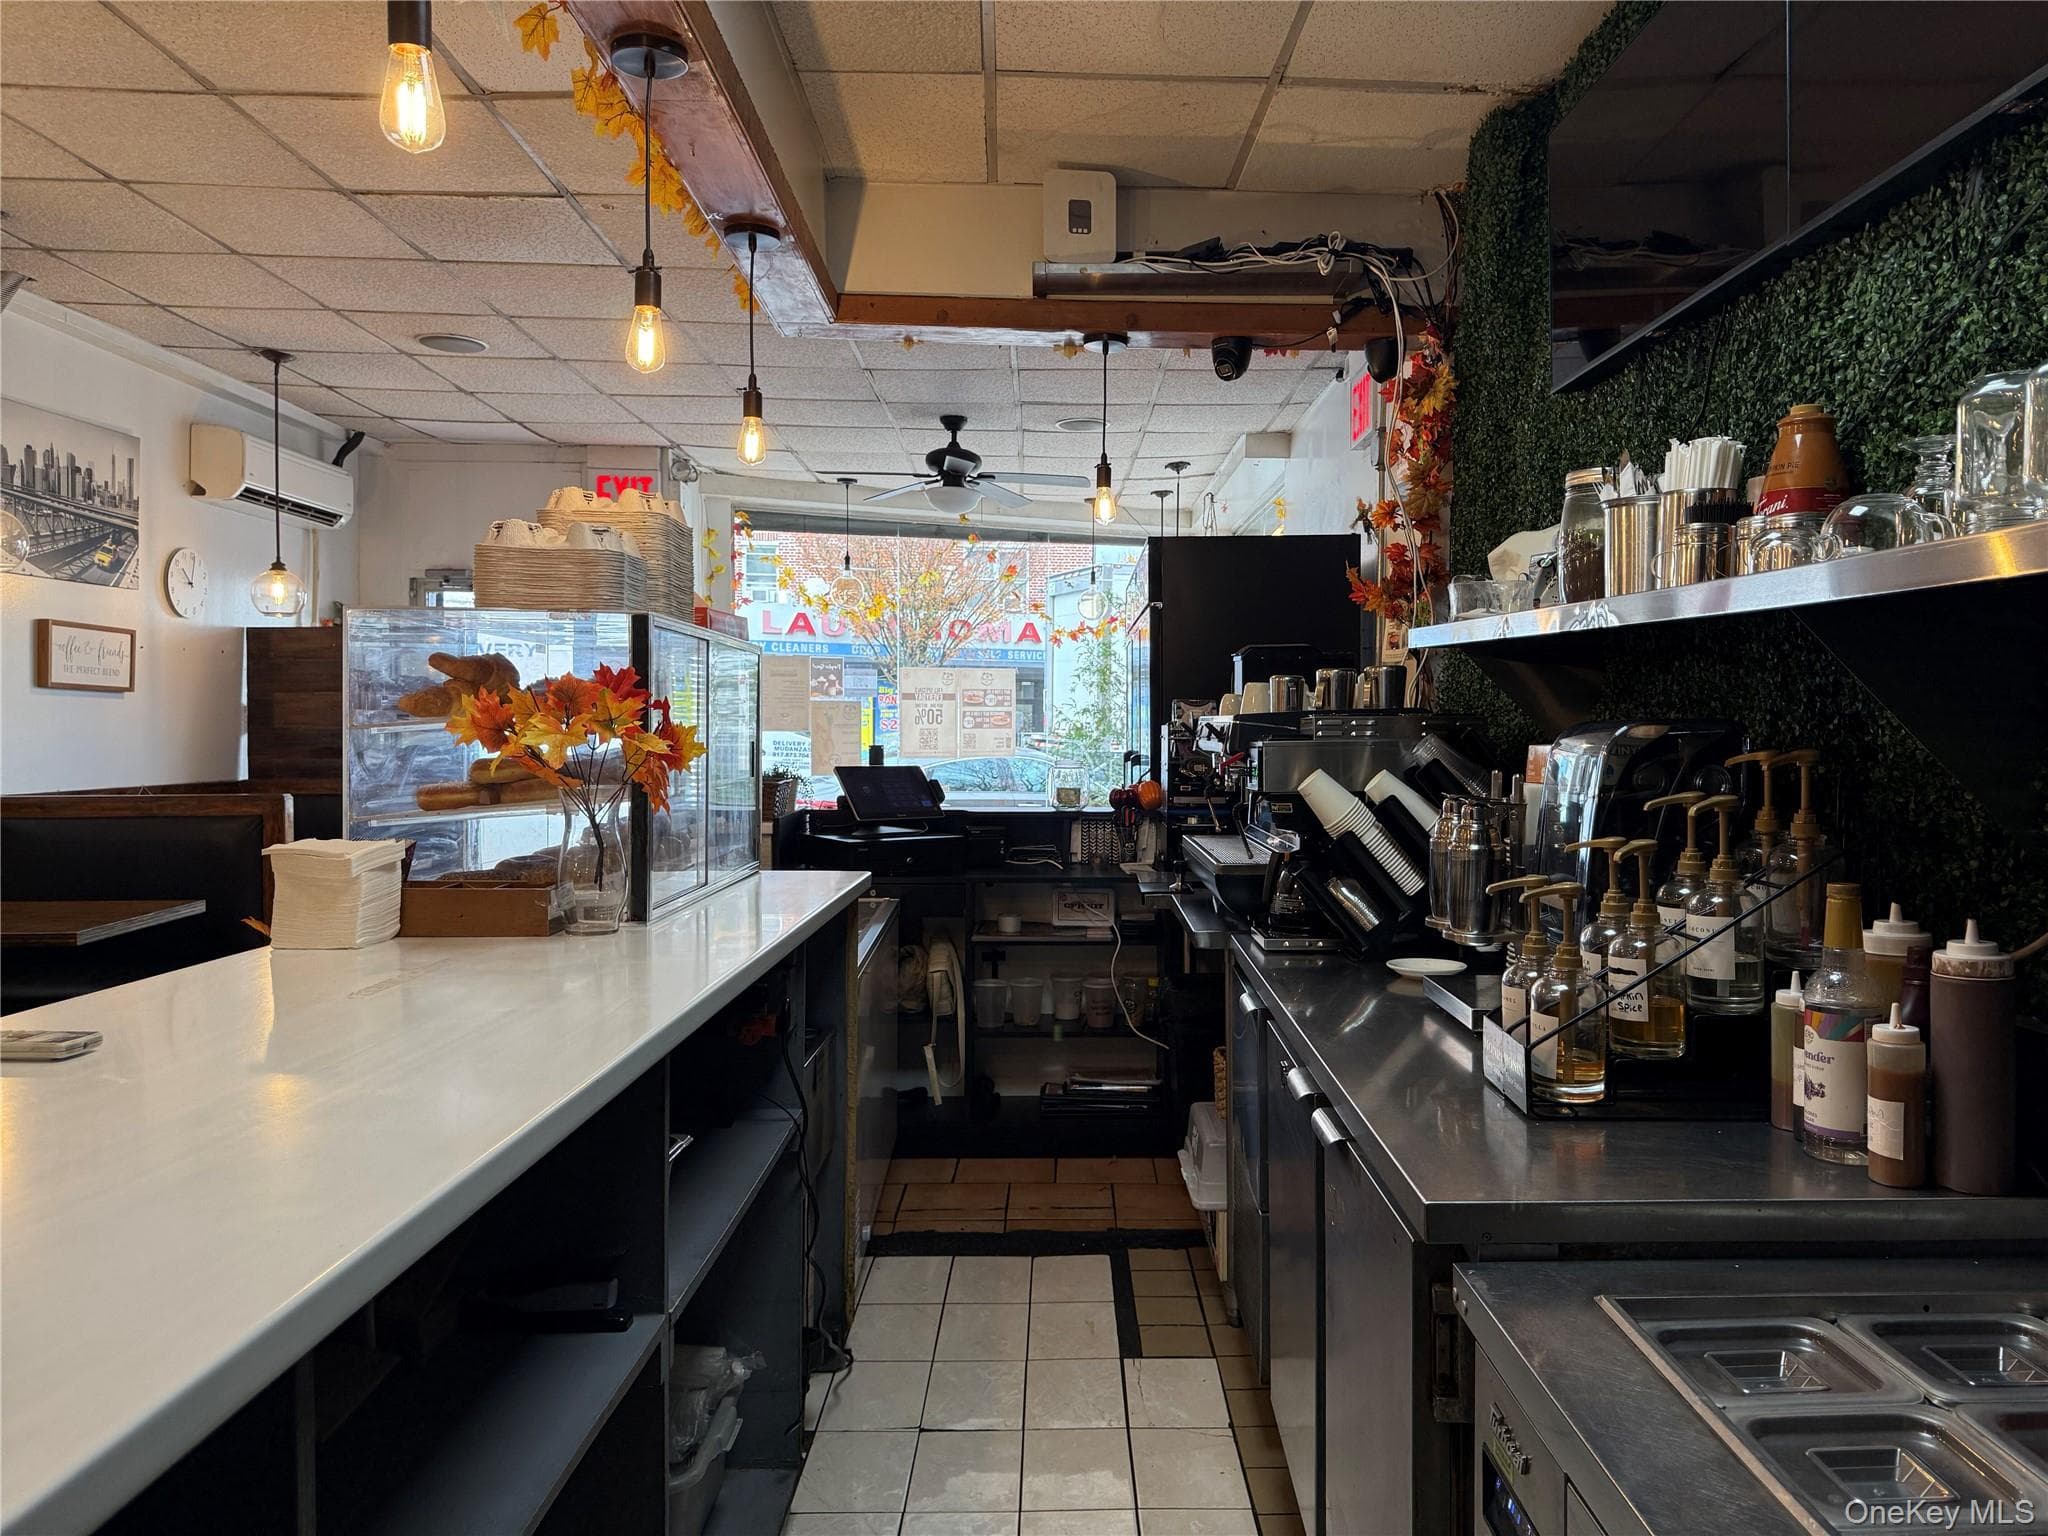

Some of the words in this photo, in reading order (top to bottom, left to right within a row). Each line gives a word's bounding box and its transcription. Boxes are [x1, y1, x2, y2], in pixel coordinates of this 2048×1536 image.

[596, 475, 654, 499] EXIT
[771, 642, 829, 654] CLEANERS
[1617, 1001, 1642, 1013] Spice
